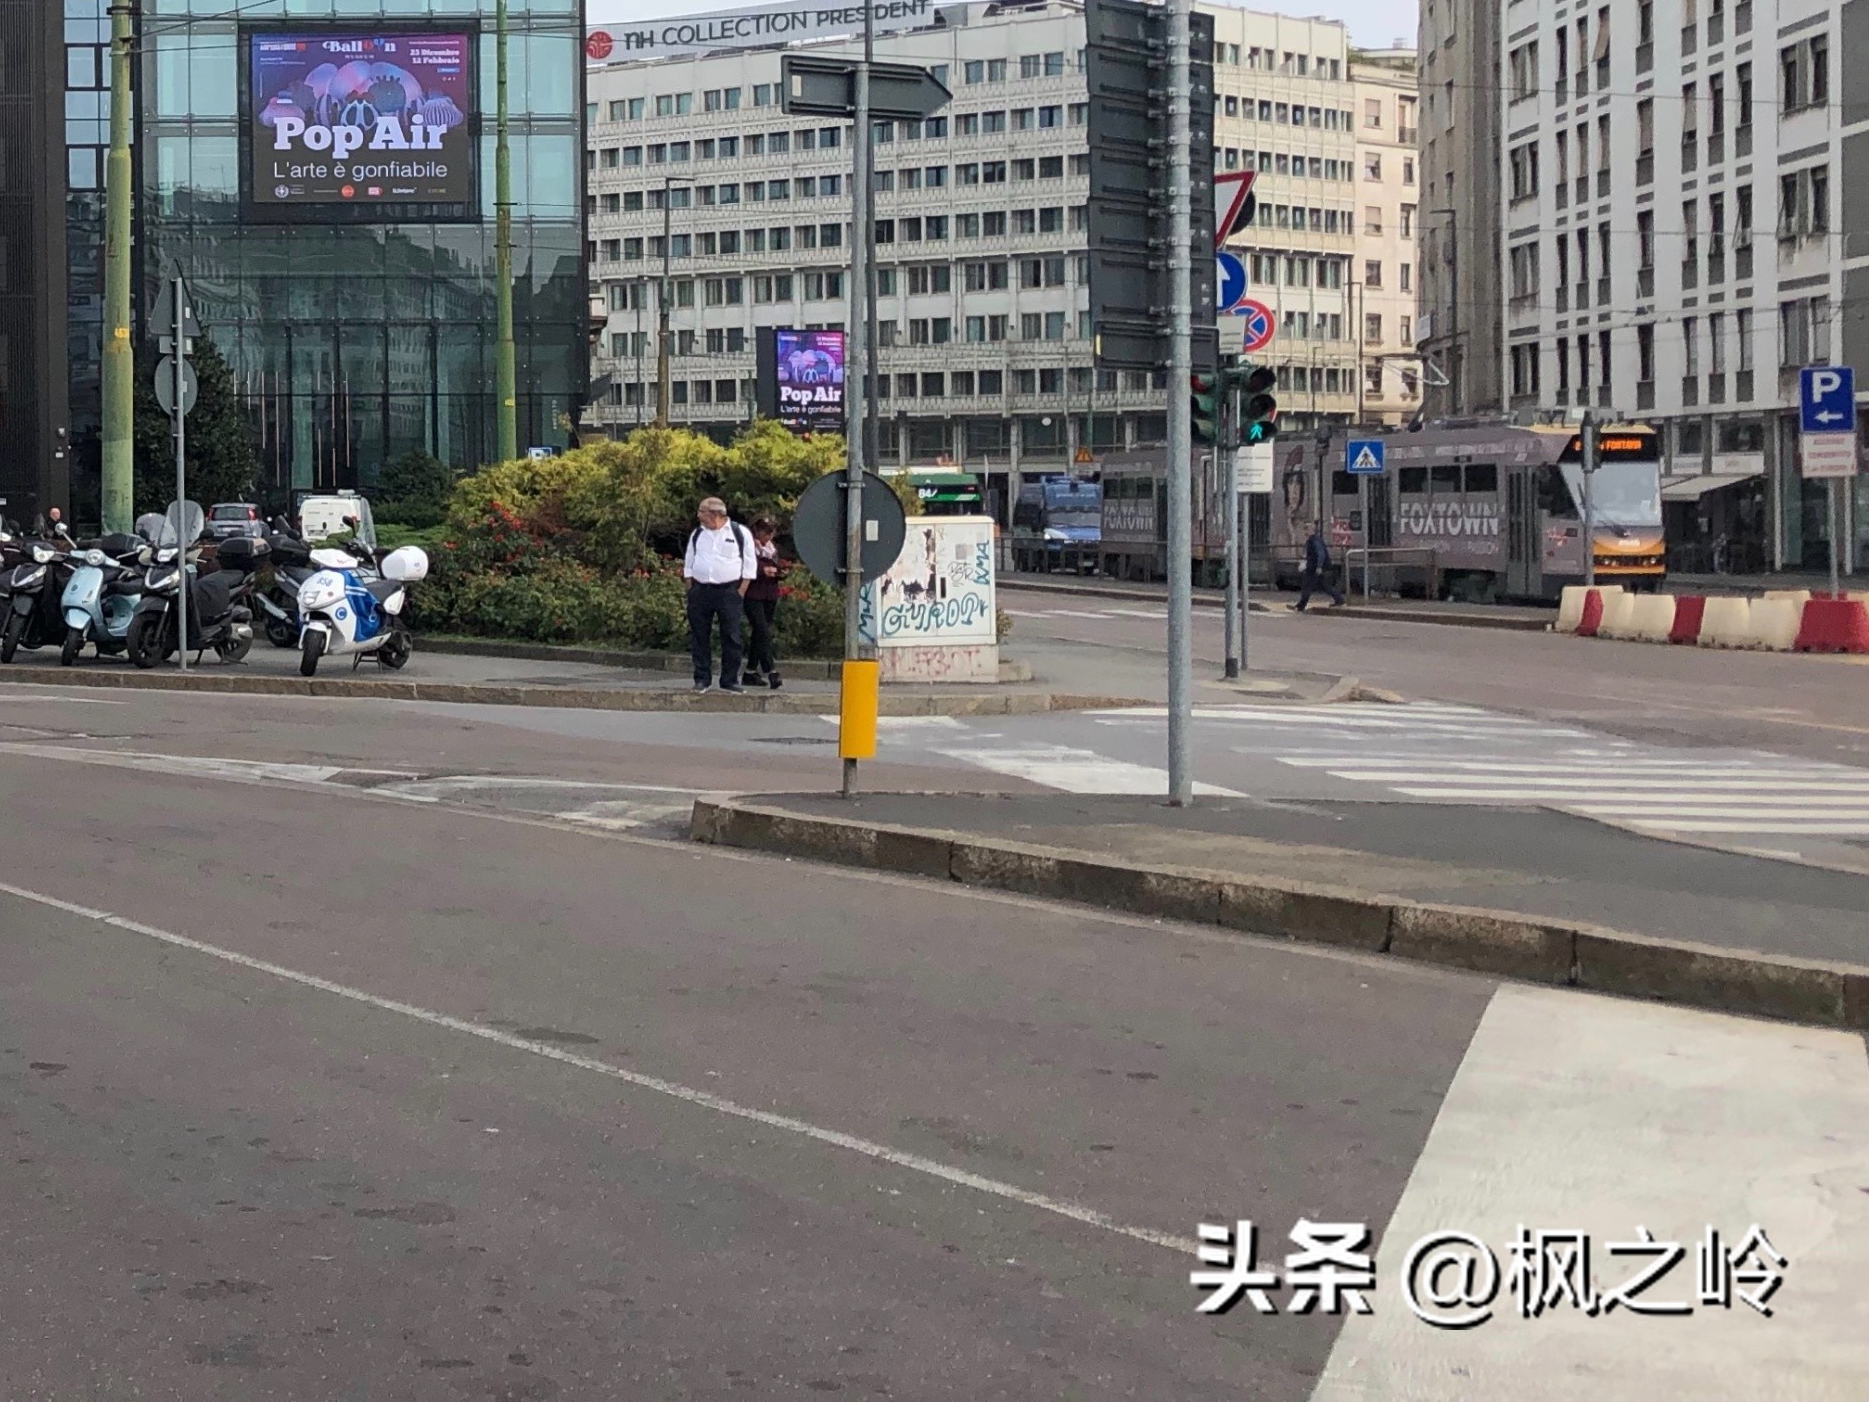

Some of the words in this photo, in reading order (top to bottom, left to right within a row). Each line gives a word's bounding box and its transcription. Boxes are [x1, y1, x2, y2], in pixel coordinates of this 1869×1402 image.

[661, 10, 808, 45] COLLECTION
[421, 48, 460, 56] Dicembre
[423, 56, 460, 64] Febbraio
[273, 116, 364, 159] Pop
[368, 114, 447, 150] Air
[273, 161, 328, 178] L'arte
[333, 162, 346, 178] è
[352, 161, 448, 182] gonfiabile
[780, 386, 813, 405] Pop
[813, 386, 842, 402] Air
[1812, 371, 1842, 403] P
[1399, 502, 1499, 536] FOXTOWN
